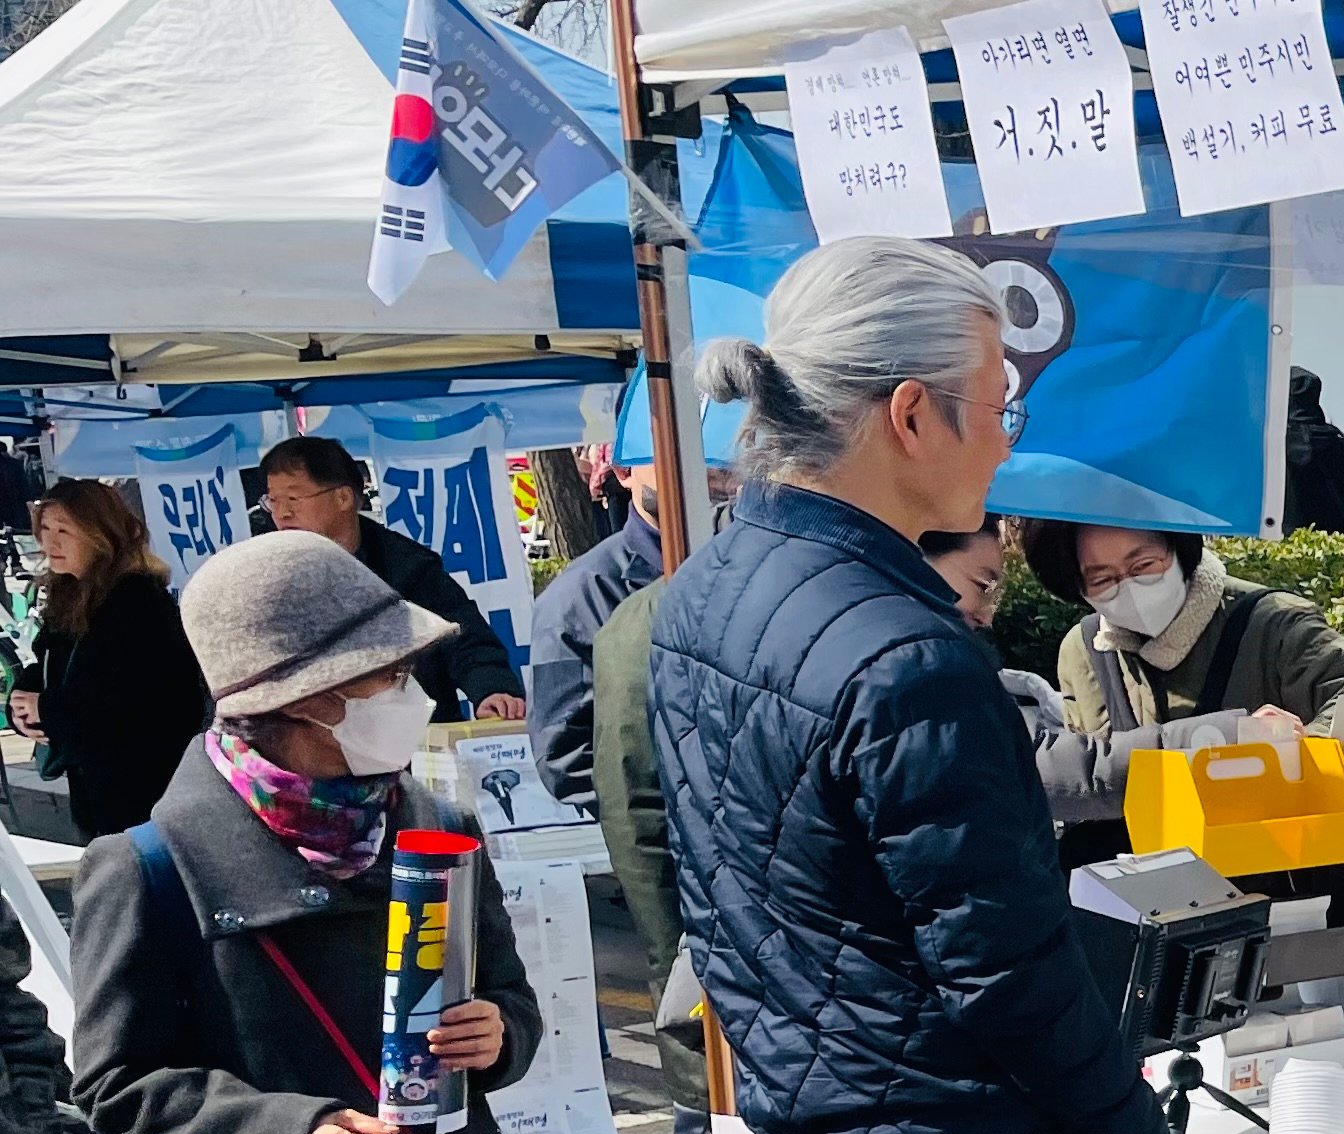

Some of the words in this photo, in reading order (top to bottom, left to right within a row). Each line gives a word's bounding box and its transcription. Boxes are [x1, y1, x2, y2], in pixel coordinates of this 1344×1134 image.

[1174, 57, 1233, 97] 어여쁜
[1237, 33, 1314, 84] 민주시민
[828, 104, 904, 139] 대한민국도
[1250, 109, 1289, 147] 커피
[1296, 103, 1338, 141] 무료
[838, 161, 907, 197] 망치려구?
